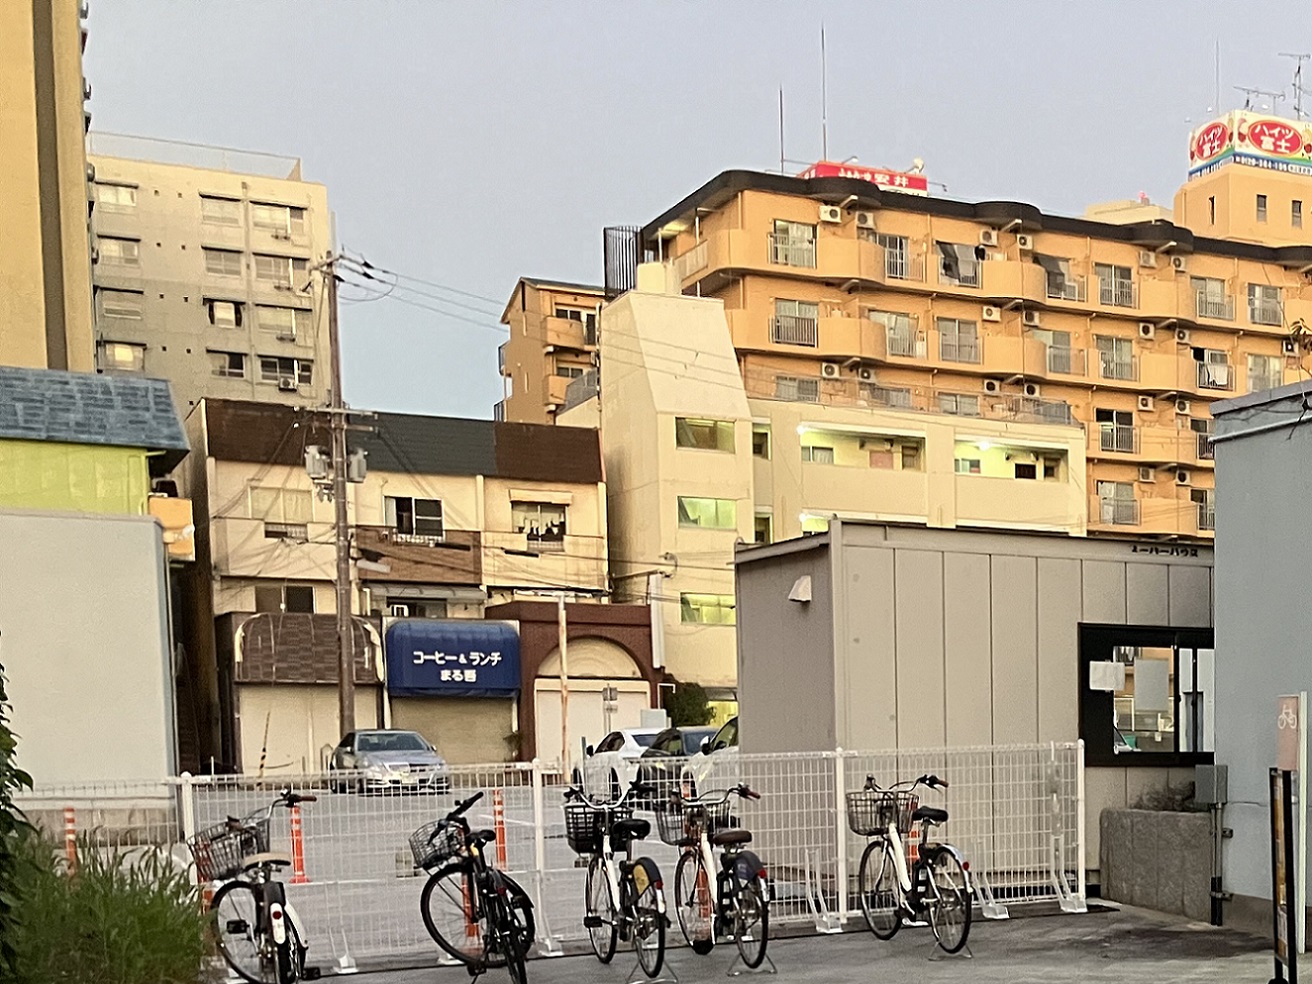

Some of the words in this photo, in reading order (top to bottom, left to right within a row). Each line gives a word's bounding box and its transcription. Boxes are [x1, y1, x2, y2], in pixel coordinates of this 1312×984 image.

[1199, 126, 1223, 146] ハイツ
[1255, 124, 1294, 139] ハイツ
[1260, 136, 1291, 153] 富士
